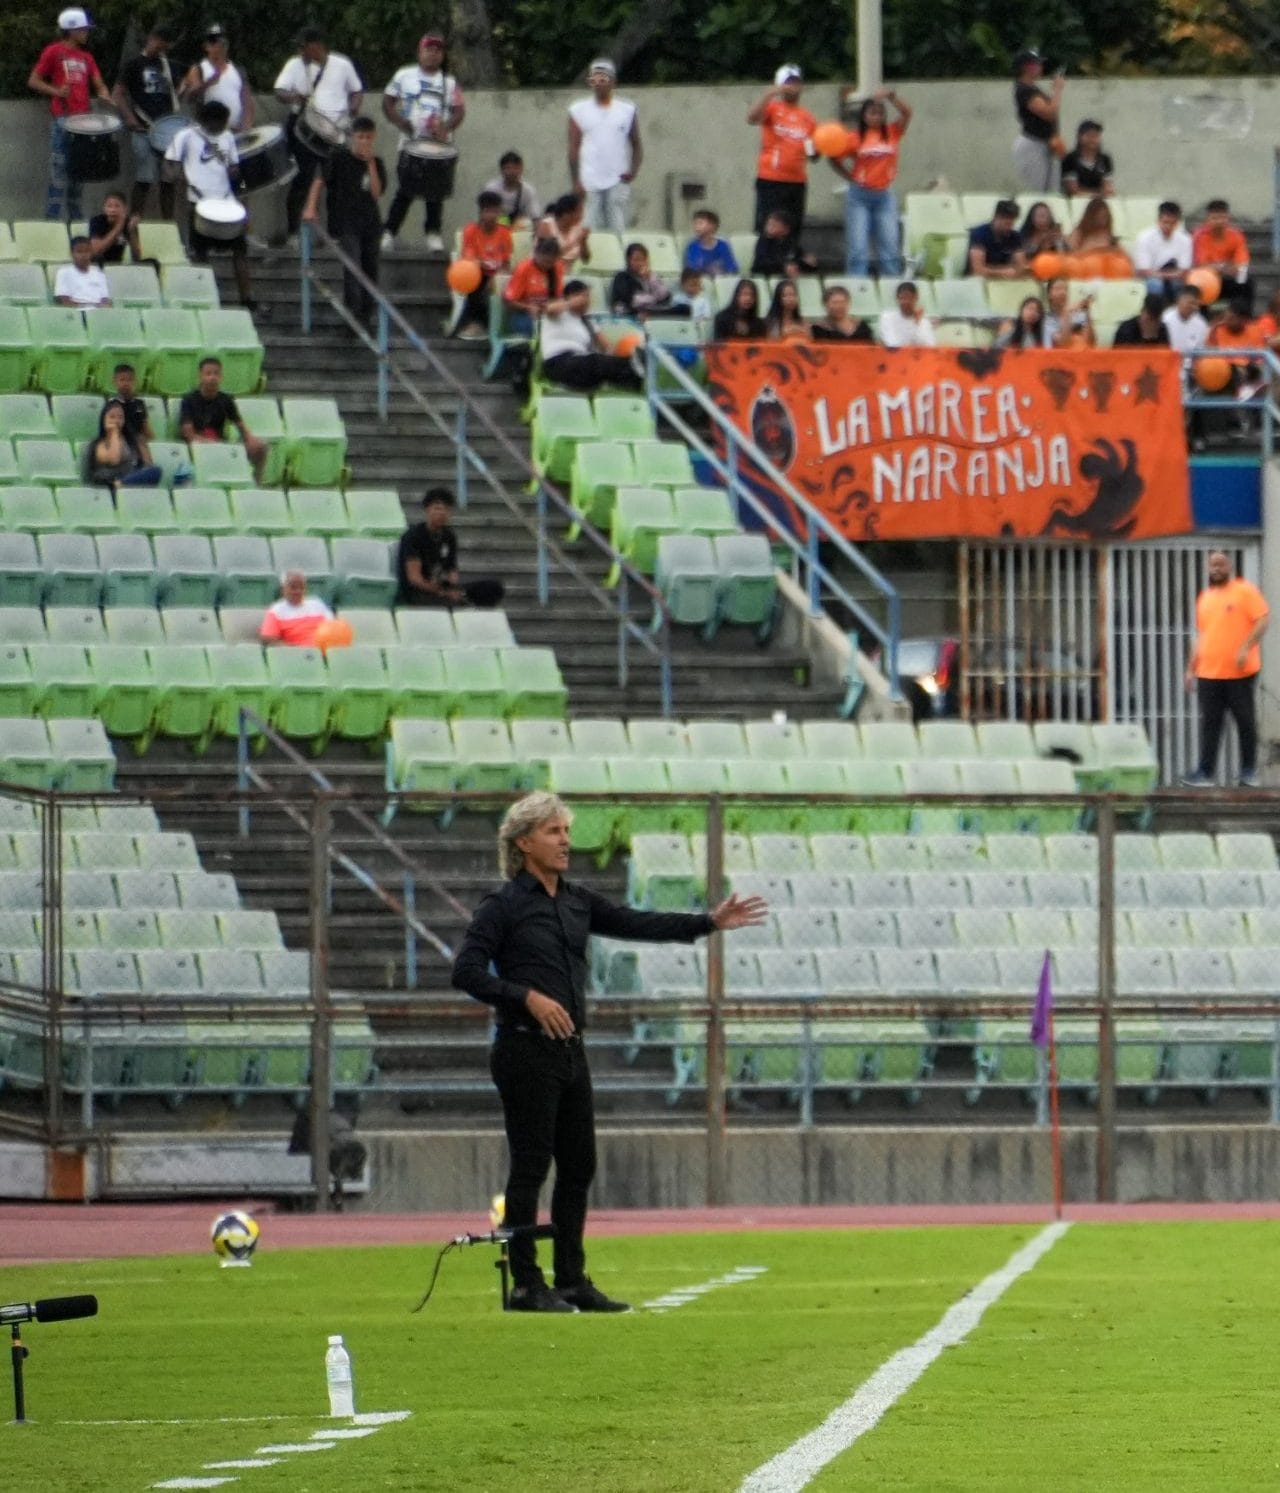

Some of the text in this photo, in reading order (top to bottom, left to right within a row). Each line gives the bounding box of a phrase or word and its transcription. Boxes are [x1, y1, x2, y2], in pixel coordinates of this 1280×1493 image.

[813, 378, 1030, 456] LA MAREA
[872, 433, 1072, 503] NARANJA
